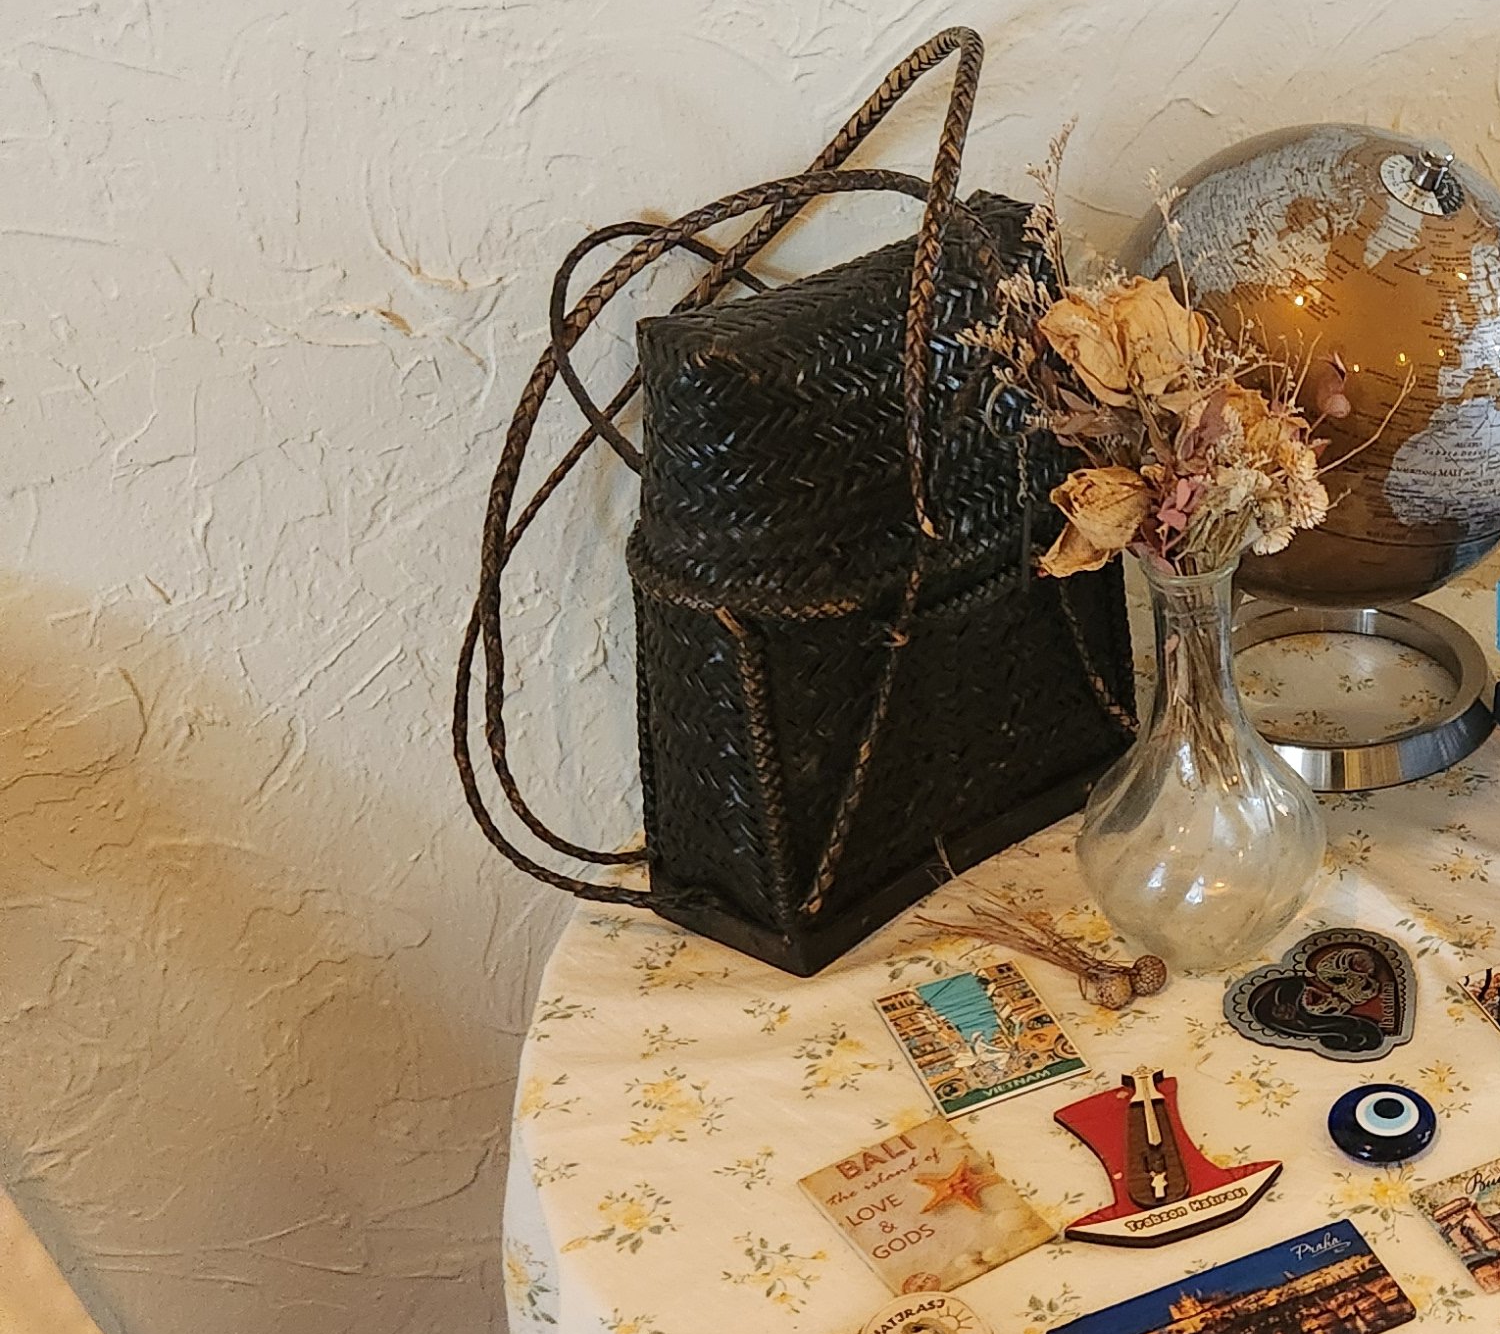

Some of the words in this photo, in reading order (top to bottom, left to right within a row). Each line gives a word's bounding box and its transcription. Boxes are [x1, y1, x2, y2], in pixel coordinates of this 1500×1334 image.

[982, 1069, 1052, 1097] VIETNAM
[836, 1134, 917, 1181] BALI
[923, 1146, 942, 1165] of
[845, 1193, 904, 1227] LOVE
[1125, 1206, 1189, 1232] Trabzon
[872, 1223, 935, 1259] GODS
[879, 1220, 898, 1234] &
[1290, 1232, 1343, 1261] Praha
